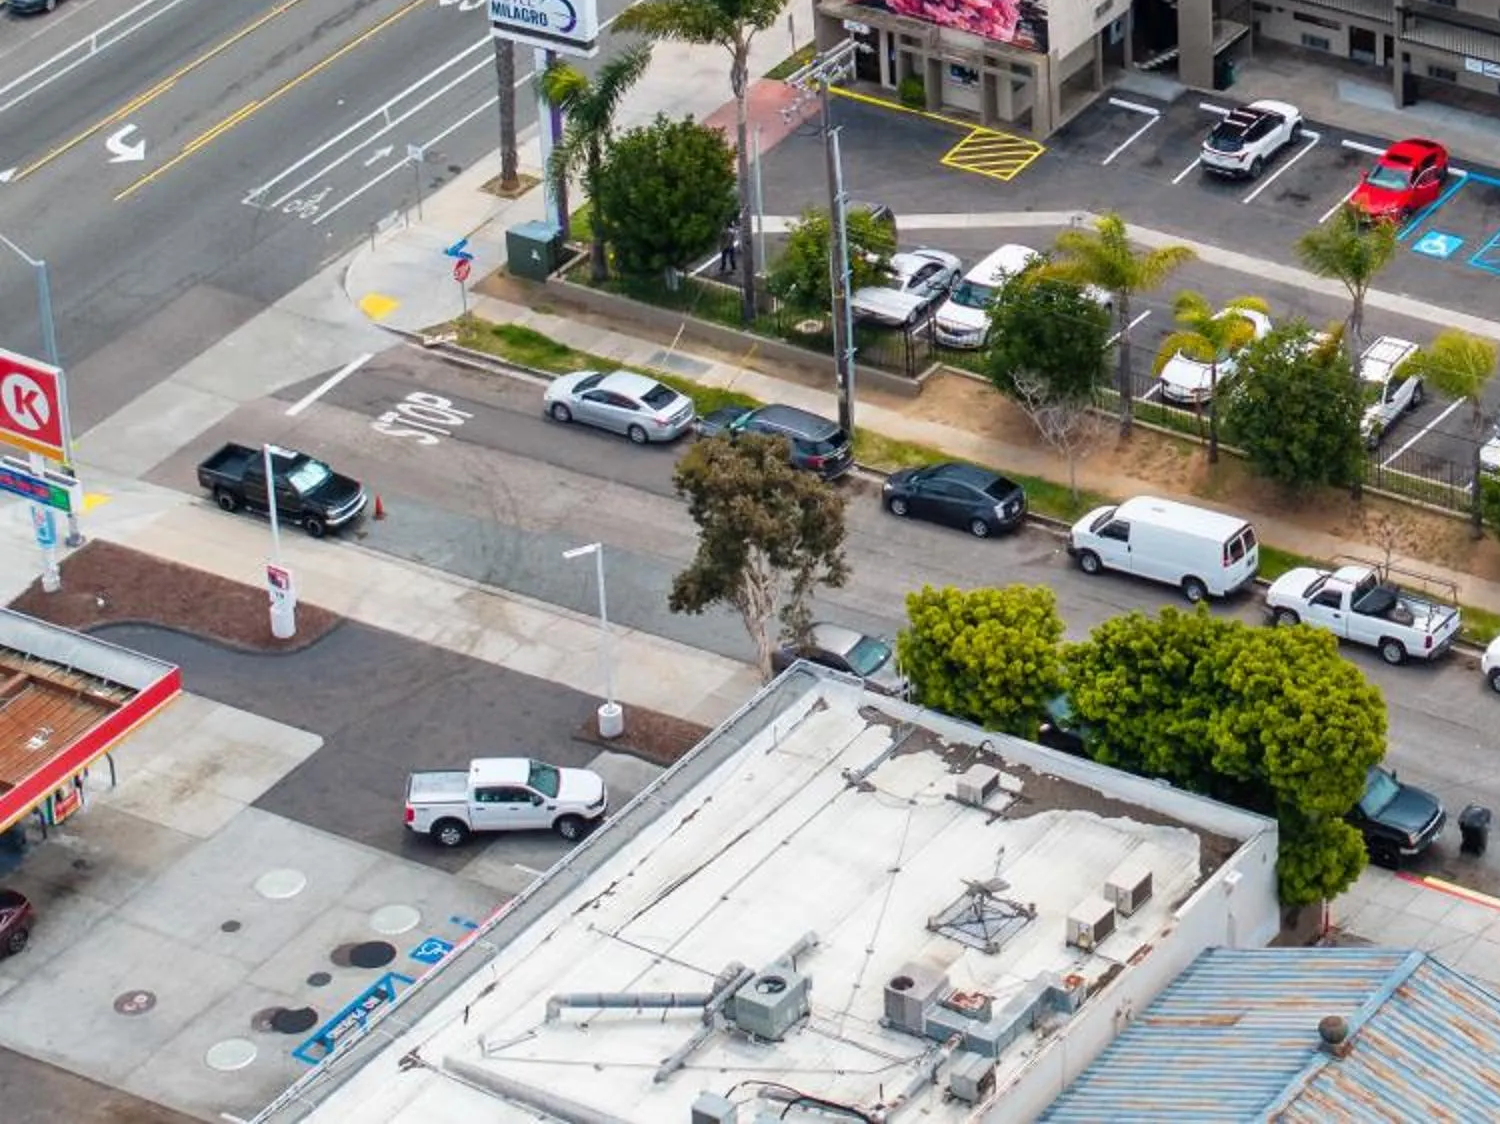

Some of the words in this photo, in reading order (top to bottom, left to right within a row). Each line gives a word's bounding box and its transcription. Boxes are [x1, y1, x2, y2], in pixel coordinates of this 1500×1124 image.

[491, 0, 549, 27] MILAGRO
[13, 384, 44, 429] K
[369, 391, 474, 445] STOP
